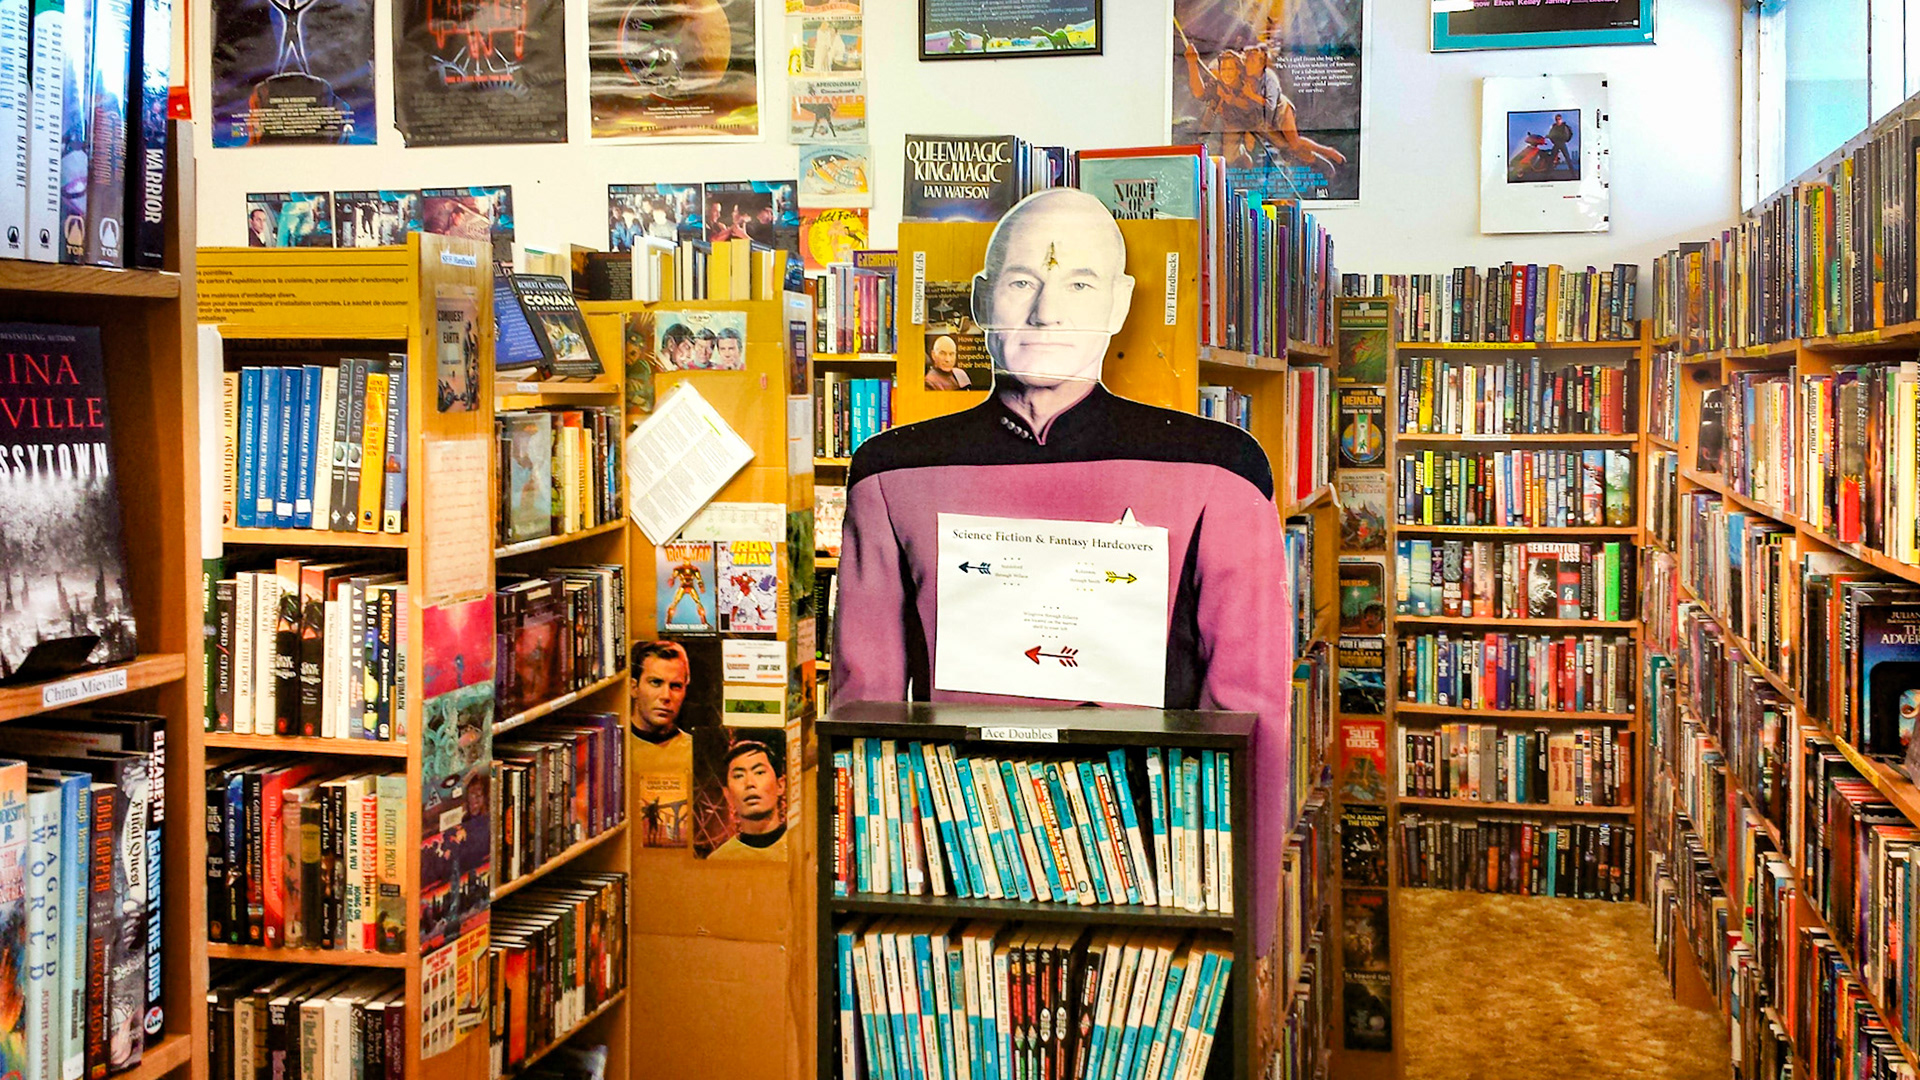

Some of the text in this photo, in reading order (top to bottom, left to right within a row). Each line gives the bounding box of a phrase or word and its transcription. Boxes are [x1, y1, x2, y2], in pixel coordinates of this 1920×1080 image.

[16, 5, 29, 188] SOULS IN THE GREAT MACHINE
[792, 96, 865, 104] UNTAMED
[48, 24, 61, 213] SOULS IN THE GREAT MACHINE
[145, 148, 163, 223] WARRIOR
[914, 162, 1002, 183] KINGMAGIC
[923, 186, 990, 199] IAN WATSON
[1113, 180, 1158, 200] NIGHT
[1129, 199, 1144, 212] OF
[101, 249, 118, 257] TOR
[524, 295, 574, 306] CONAN
[915, 253, 923, 323] SF/F Hardbacks
[1166, 253, 1177, 324] SF/F Hardbacks
[1514, 279, 1523, 305] PARASITE
[438, 311, 464, 321] CONQUEST
[443, 332, 460, 344] EARTH
[337, 364, 348, 437] GENE WOLFE
[352, 366, 364, 437] GENE WOLFE
[388, 374, 400, 452] Pirate Freedom
[1342, 396, 1382, 405] HEINLEIN
[665, 545, 712, 562] IRON MAN
[730, 541, 773, 552] IRON
[953, 530, 1154, 551] Science Fiction & Fantasy Hardcovers
[732, 552, 772, 565] MAN
[220, 612, 228, 646] SWORD
[353, 587, 362, 669] AMBIENT
[379, 592, 392, 645] elvissey
[220, 654, 228, 694] CITADEL
[397, 653, 405, 673] JACK
[45, 687, 77, 703] China
[985, 729, 1052, 739] Ace Doubles
[1346, 739, 1380, 748] DOGS
[1349, 729, 1375, 738] SUN
[1592, 736, 1602, 762] Friday
[153, 730, 165, 822] ELIZABETH
[840, 771, 845, 782] NO
[1040, 779, 1070, 872] SANCTUARY IN THE SKY
[1100, 776, 1127, 855] BEYOND THE SILVER SKY
[95, 795, 113, 892] COLD COPPER
[129, 800, 144, 888] Final Quest
[384, 809, 396, 878] FUGITIVE PRINCE
[1558, 828, 1566, 849] DUNE
[1600, 827, 1610, 845] DUNE
[350, 856, 357, 869] WU
[30, 828, 46, 982] WORLD
[46, 825, 58, 977] RAGGED
[147, 828, 161, 1002] AGAINST THE ODDS
[91, 939, 103, 1056] DEVON MONK
